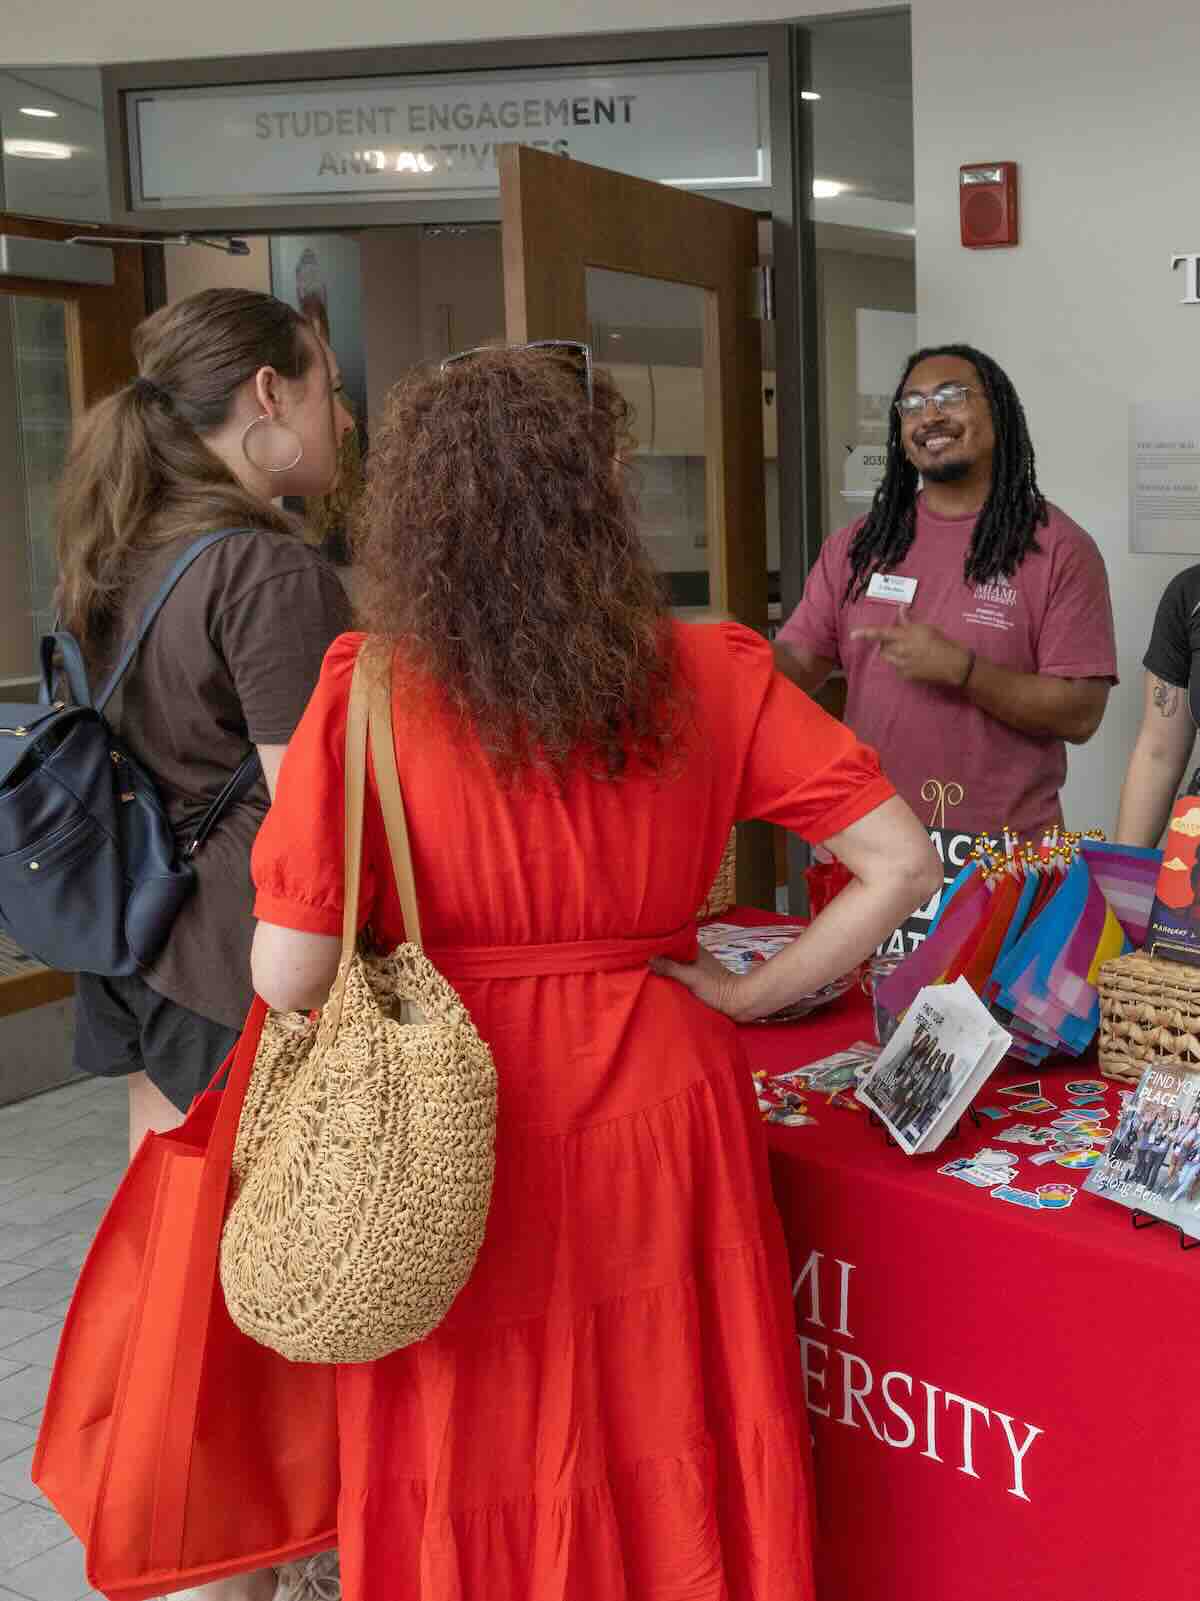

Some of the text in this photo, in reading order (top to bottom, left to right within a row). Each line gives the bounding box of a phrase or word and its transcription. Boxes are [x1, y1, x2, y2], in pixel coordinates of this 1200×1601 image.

[255, 96, 637, 141] STUDENT ENGAGEMENT
[318, 150, 385, 177] AND
[1145, 1071, 1175, 1089] FIND
[1138, 1087, 1178, 1108] PLACE
